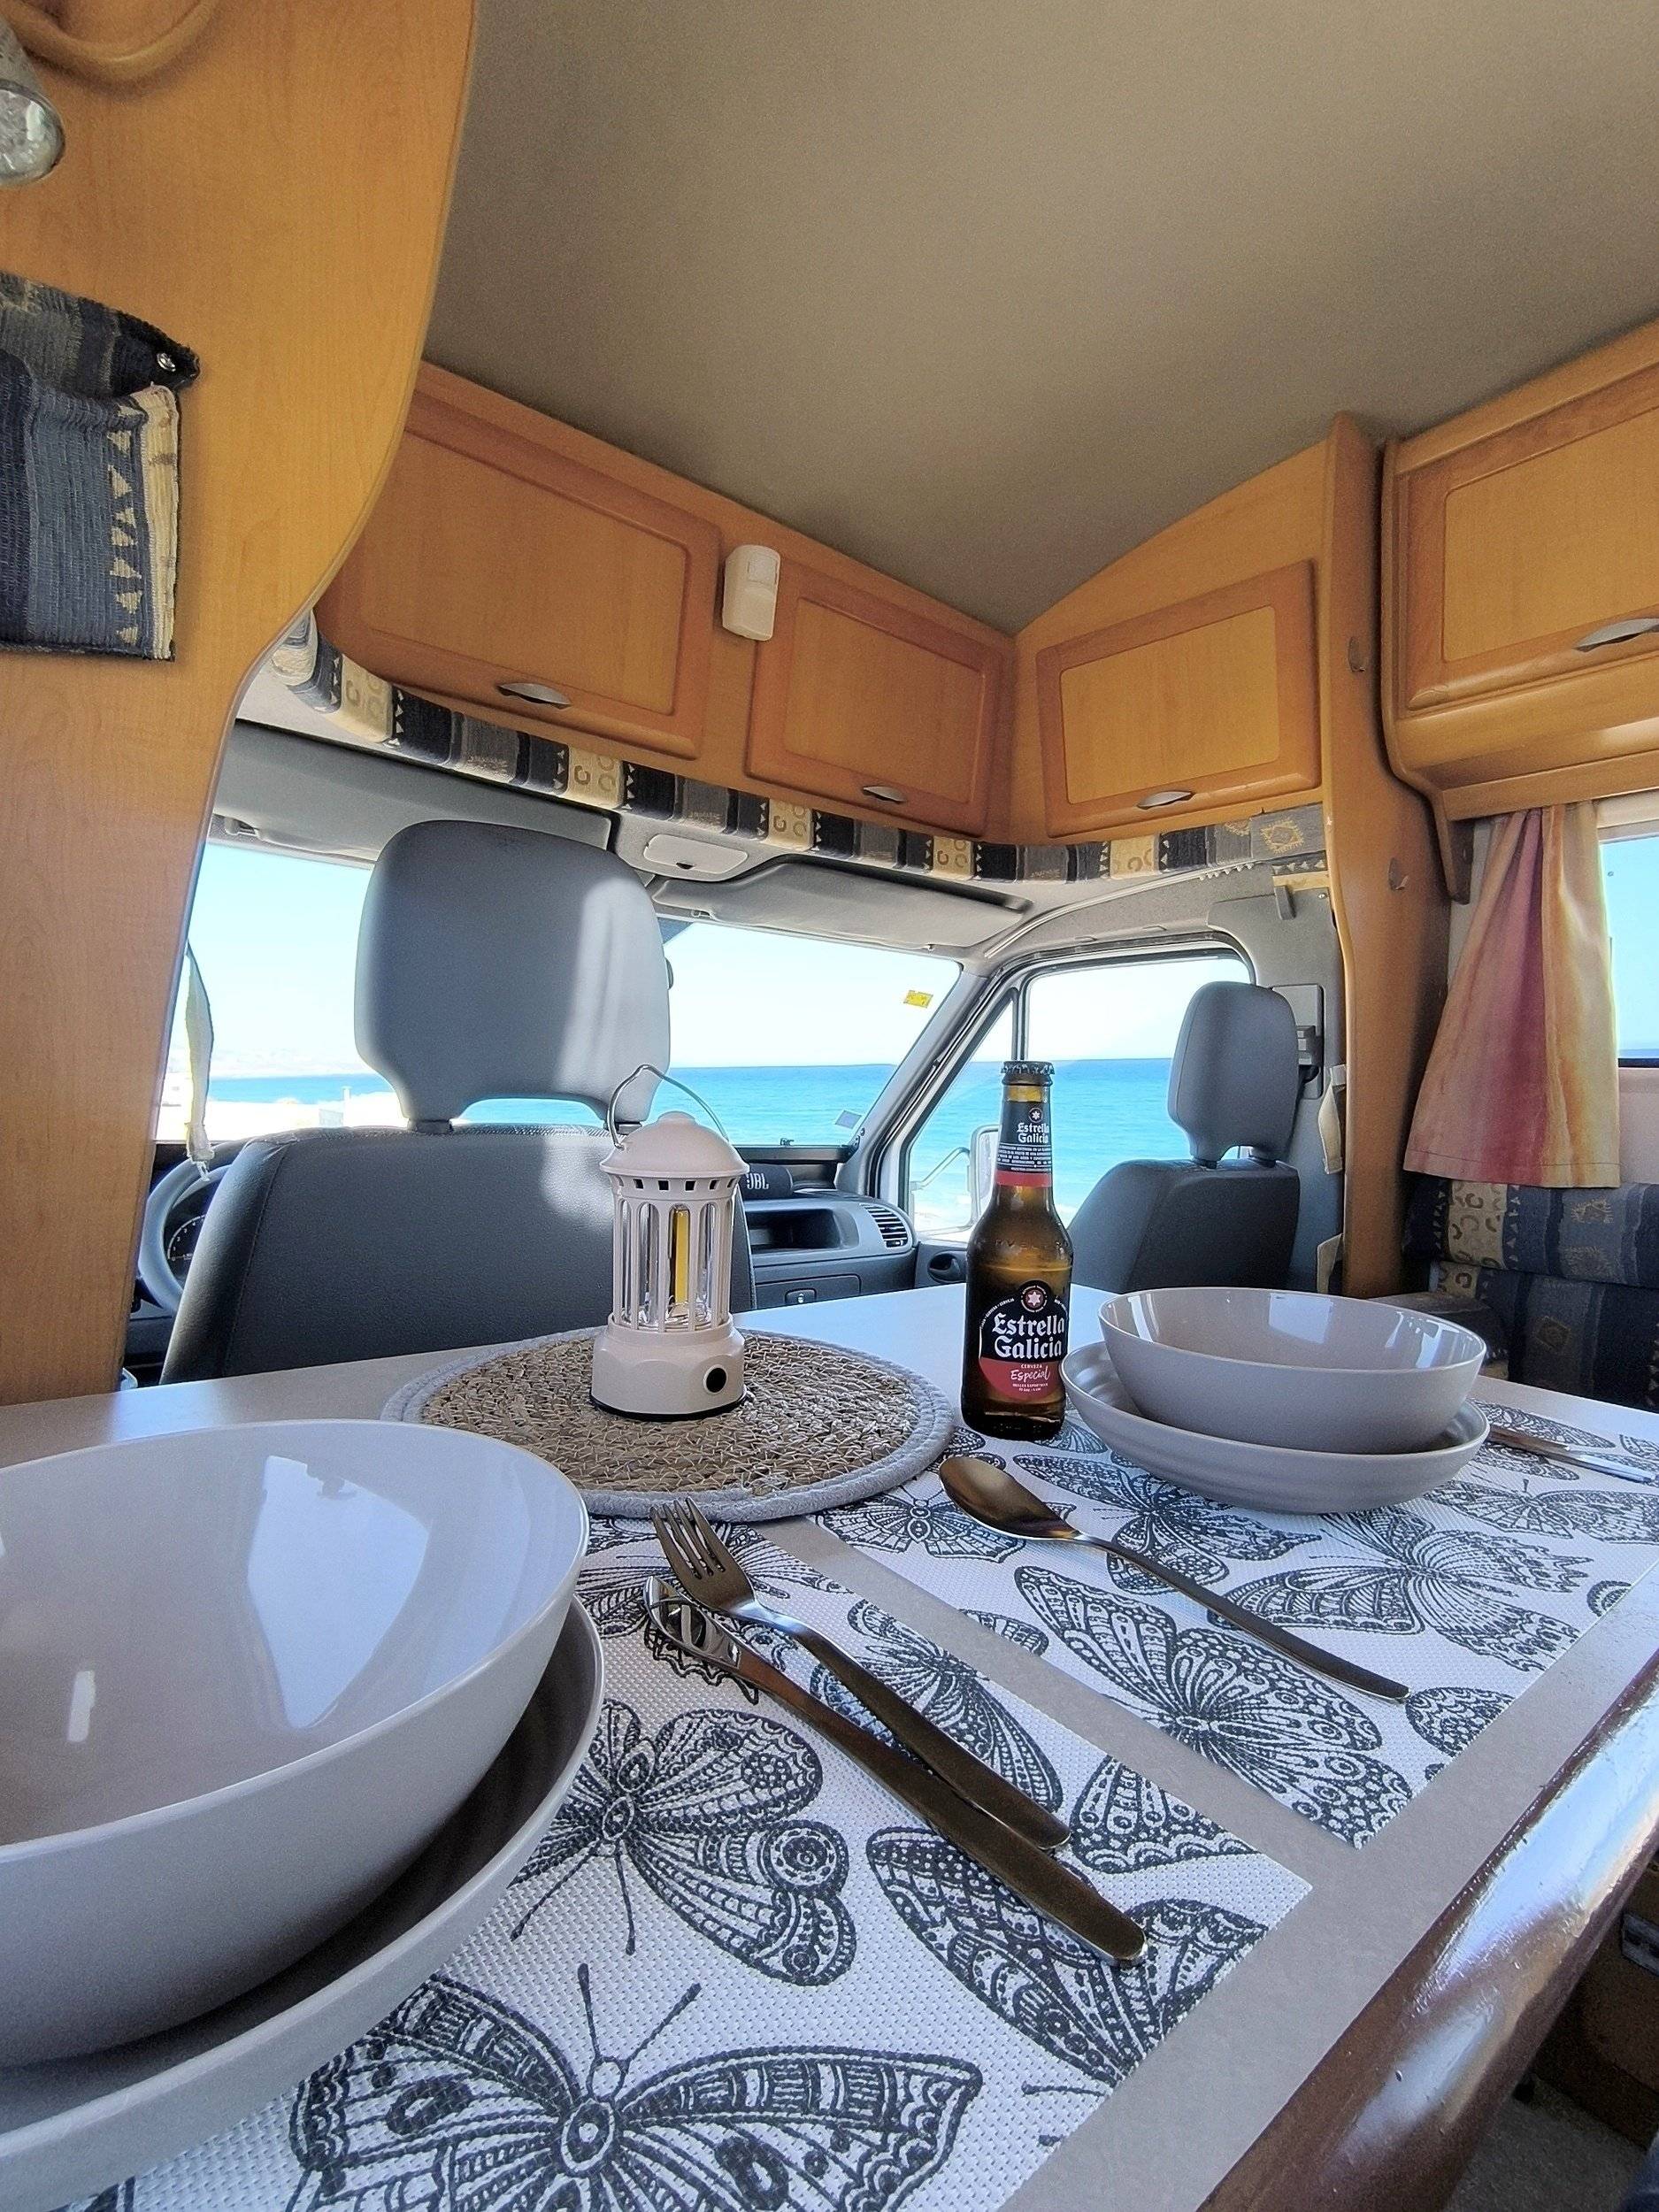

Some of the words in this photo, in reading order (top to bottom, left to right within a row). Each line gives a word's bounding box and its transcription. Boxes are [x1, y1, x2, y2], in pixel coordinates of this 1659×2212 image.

[1017, 1122, 1049, 1133] Estrella
[1018, 1133, 1048, 1144] Galicia
[747, 1172, 769, 1190] JBL
[992, 1312, 1064, 1337] Estrella
[995, 1335, 1062, 1359] Galicia
[1010, 1365, 1051, 1383] Especial
